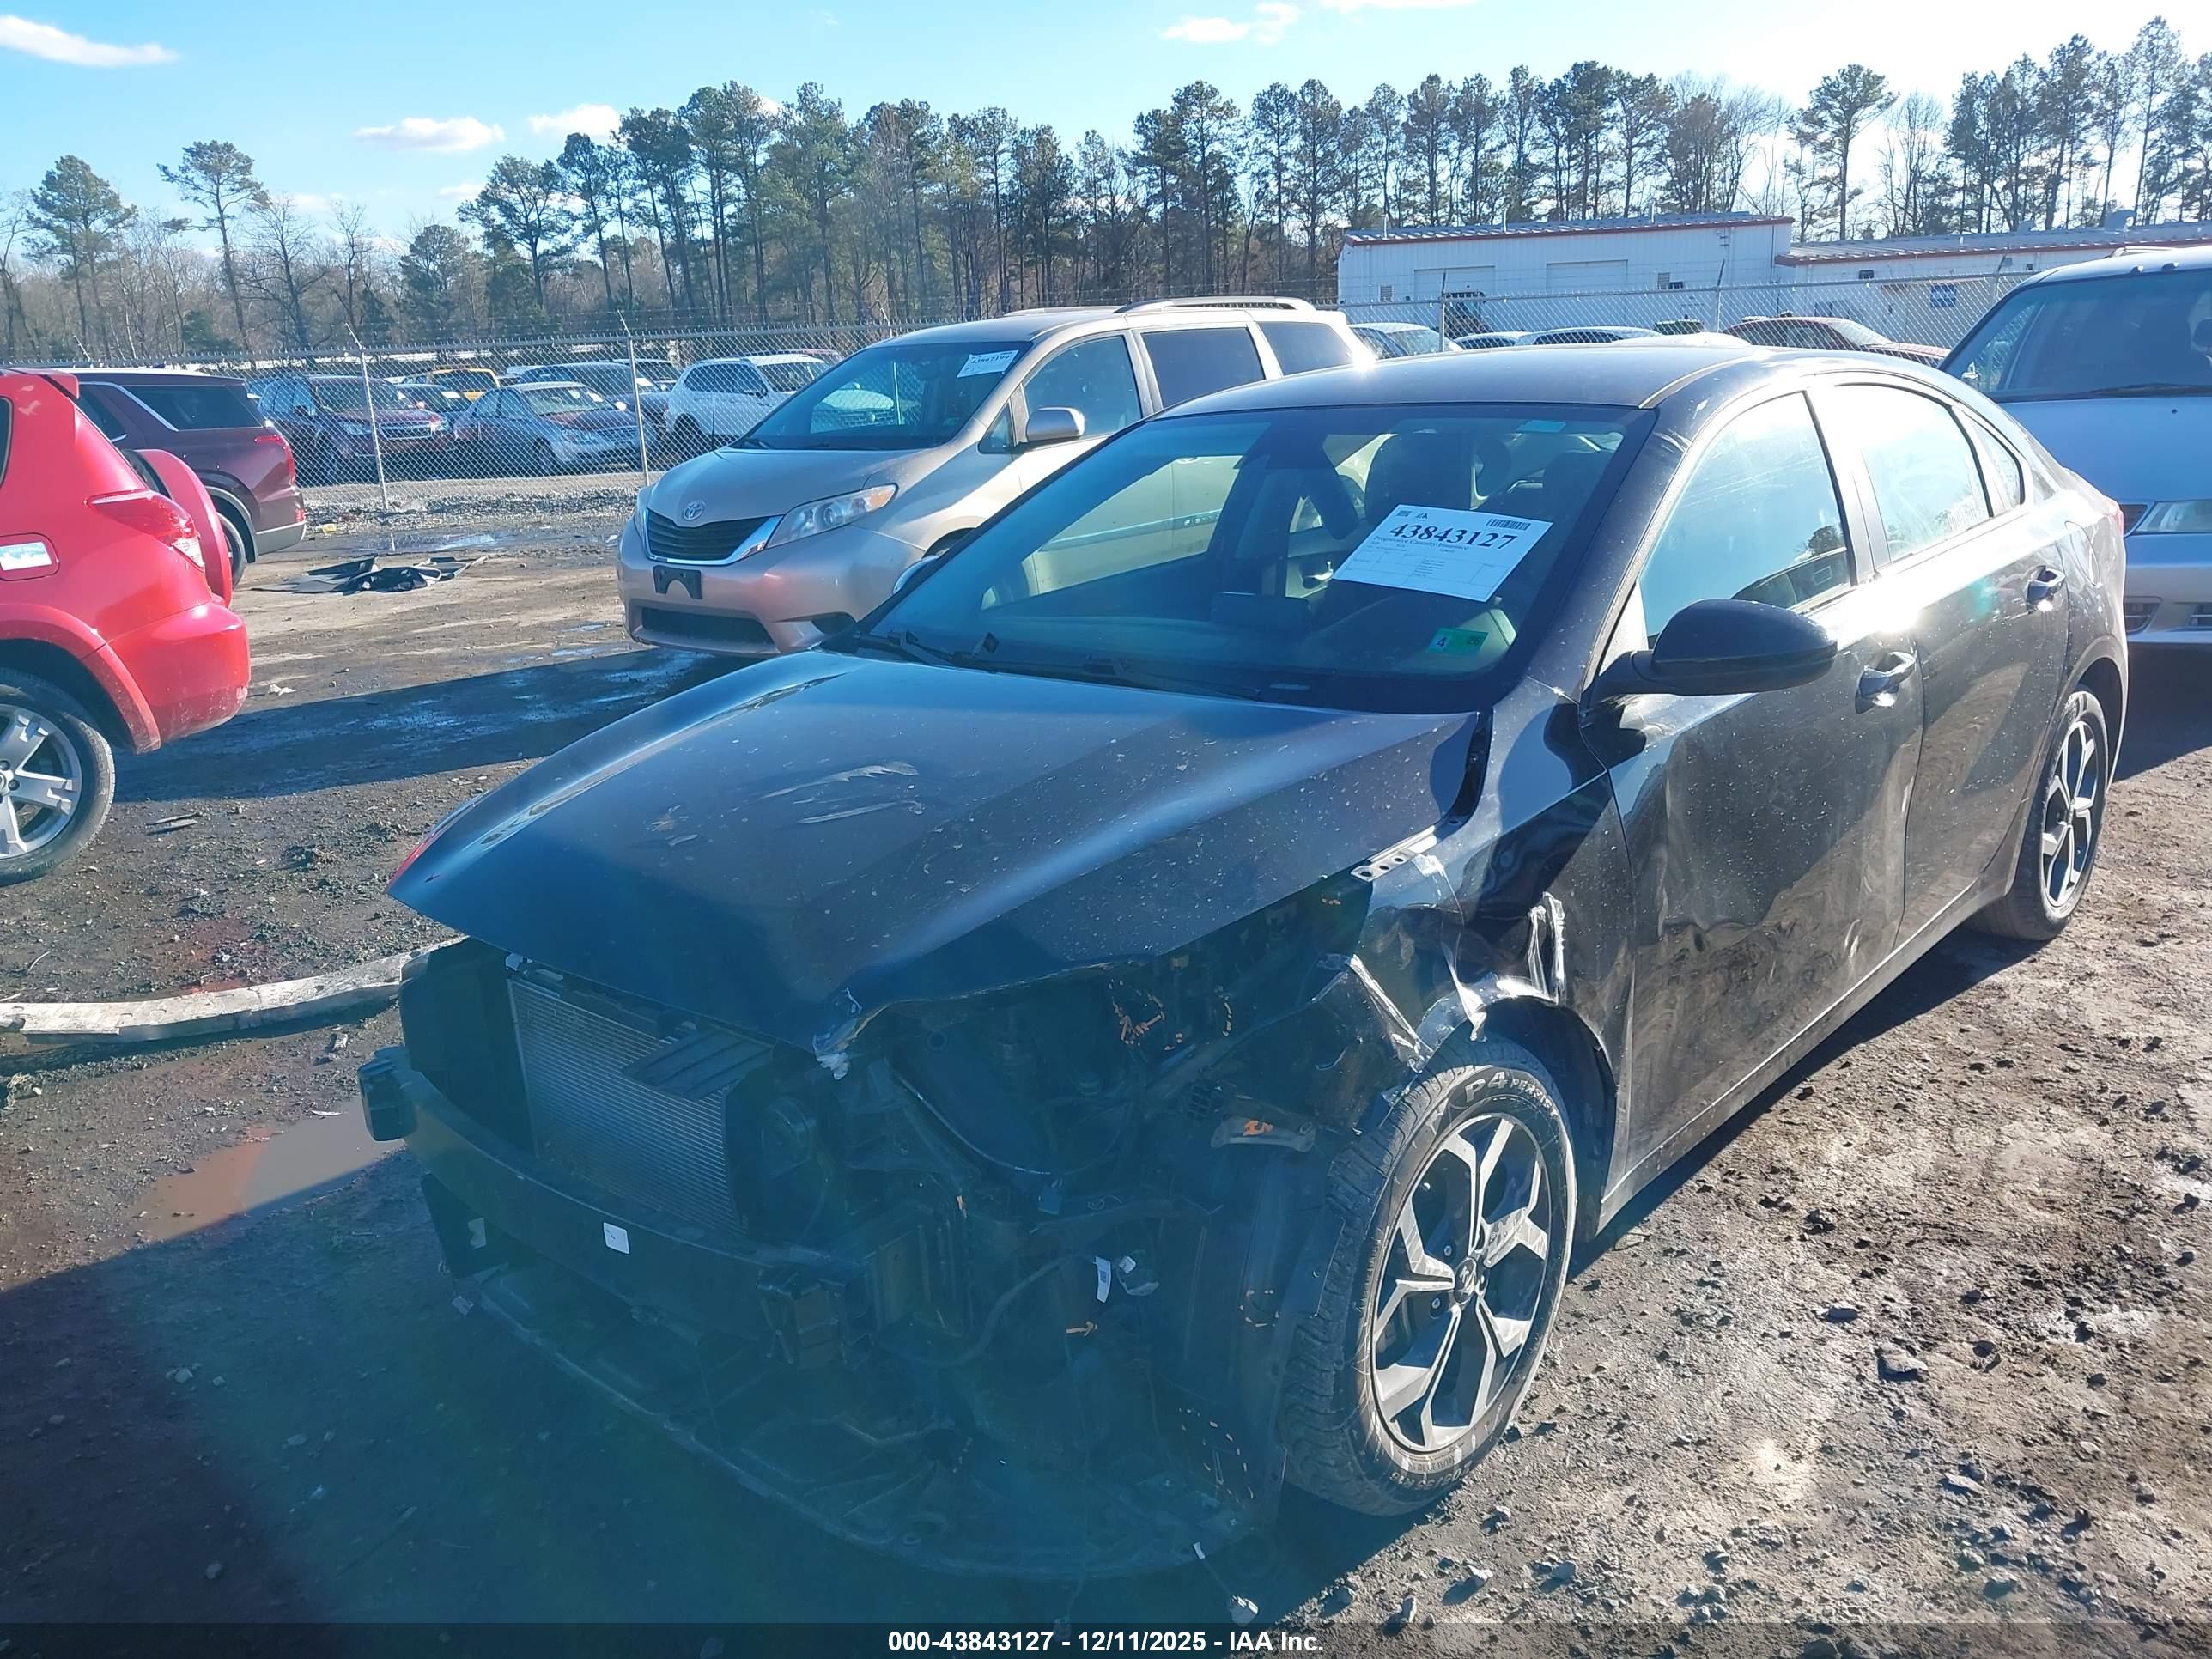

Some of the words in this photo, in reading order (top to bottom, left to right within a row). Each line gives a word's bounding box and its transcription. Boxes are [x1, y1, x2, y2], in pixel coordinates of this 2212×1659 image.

[1389, 523, 1518, 550] 43843127
[1436, 636, 1447, 647] 4
[1465, 1071, 1508, 1103] P4
